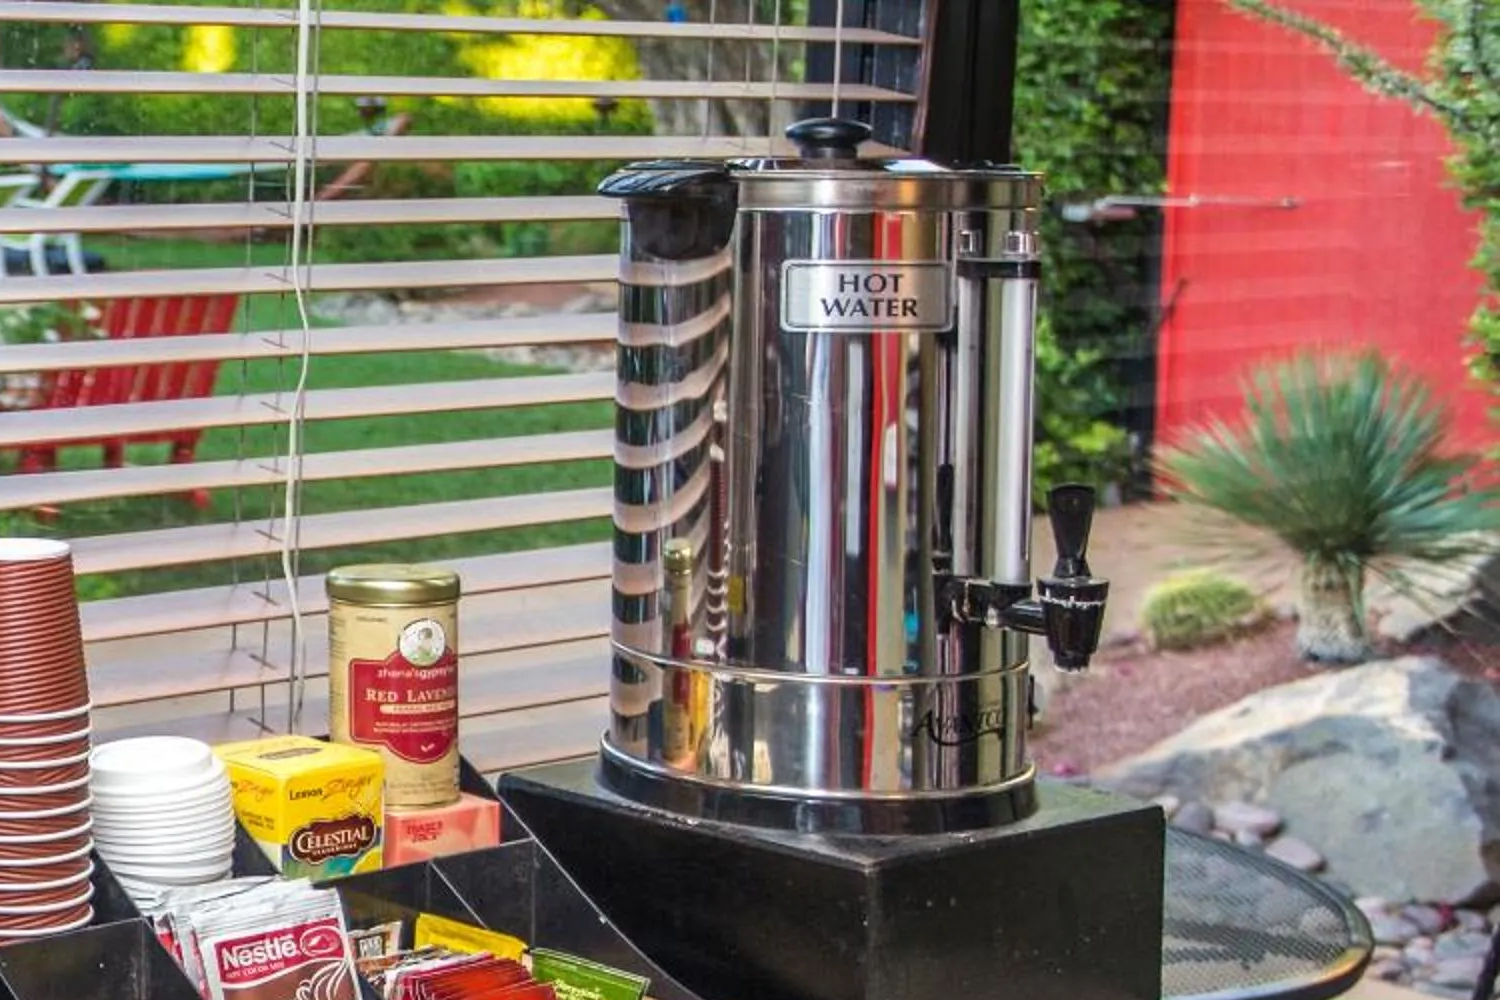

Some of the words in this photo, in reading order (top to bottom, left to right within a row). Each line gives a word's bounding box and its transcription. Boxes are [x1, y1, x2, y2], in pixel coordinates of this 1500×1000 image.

[838, 273, 904, 294] HOT
[820, 297, 919, 318] WATER
[364, 686, 399, 703] RED
[288, 787, 324, 801] Lemon
[296, 825, 372, 853] CELESTIAL
